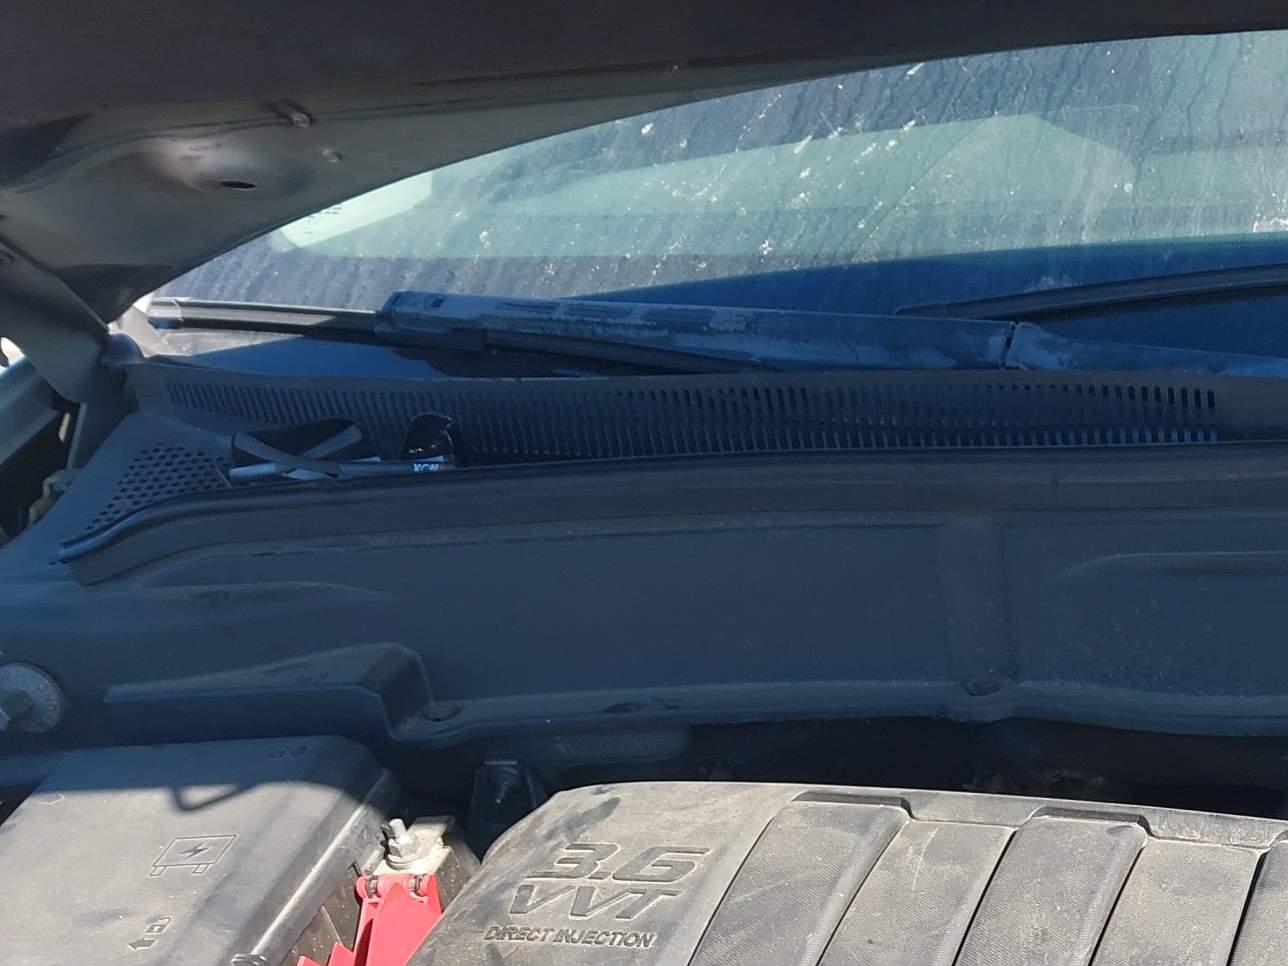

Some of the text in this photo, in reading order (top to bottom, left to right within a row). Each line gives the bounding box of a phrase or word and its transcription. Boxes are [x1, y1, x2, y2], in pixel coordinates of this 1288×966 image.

[525, 842, 711, 884] 3.6
[509, 883, 681, 921] VVT
[483, 926, 657, 949] DIRECT INJECTION
